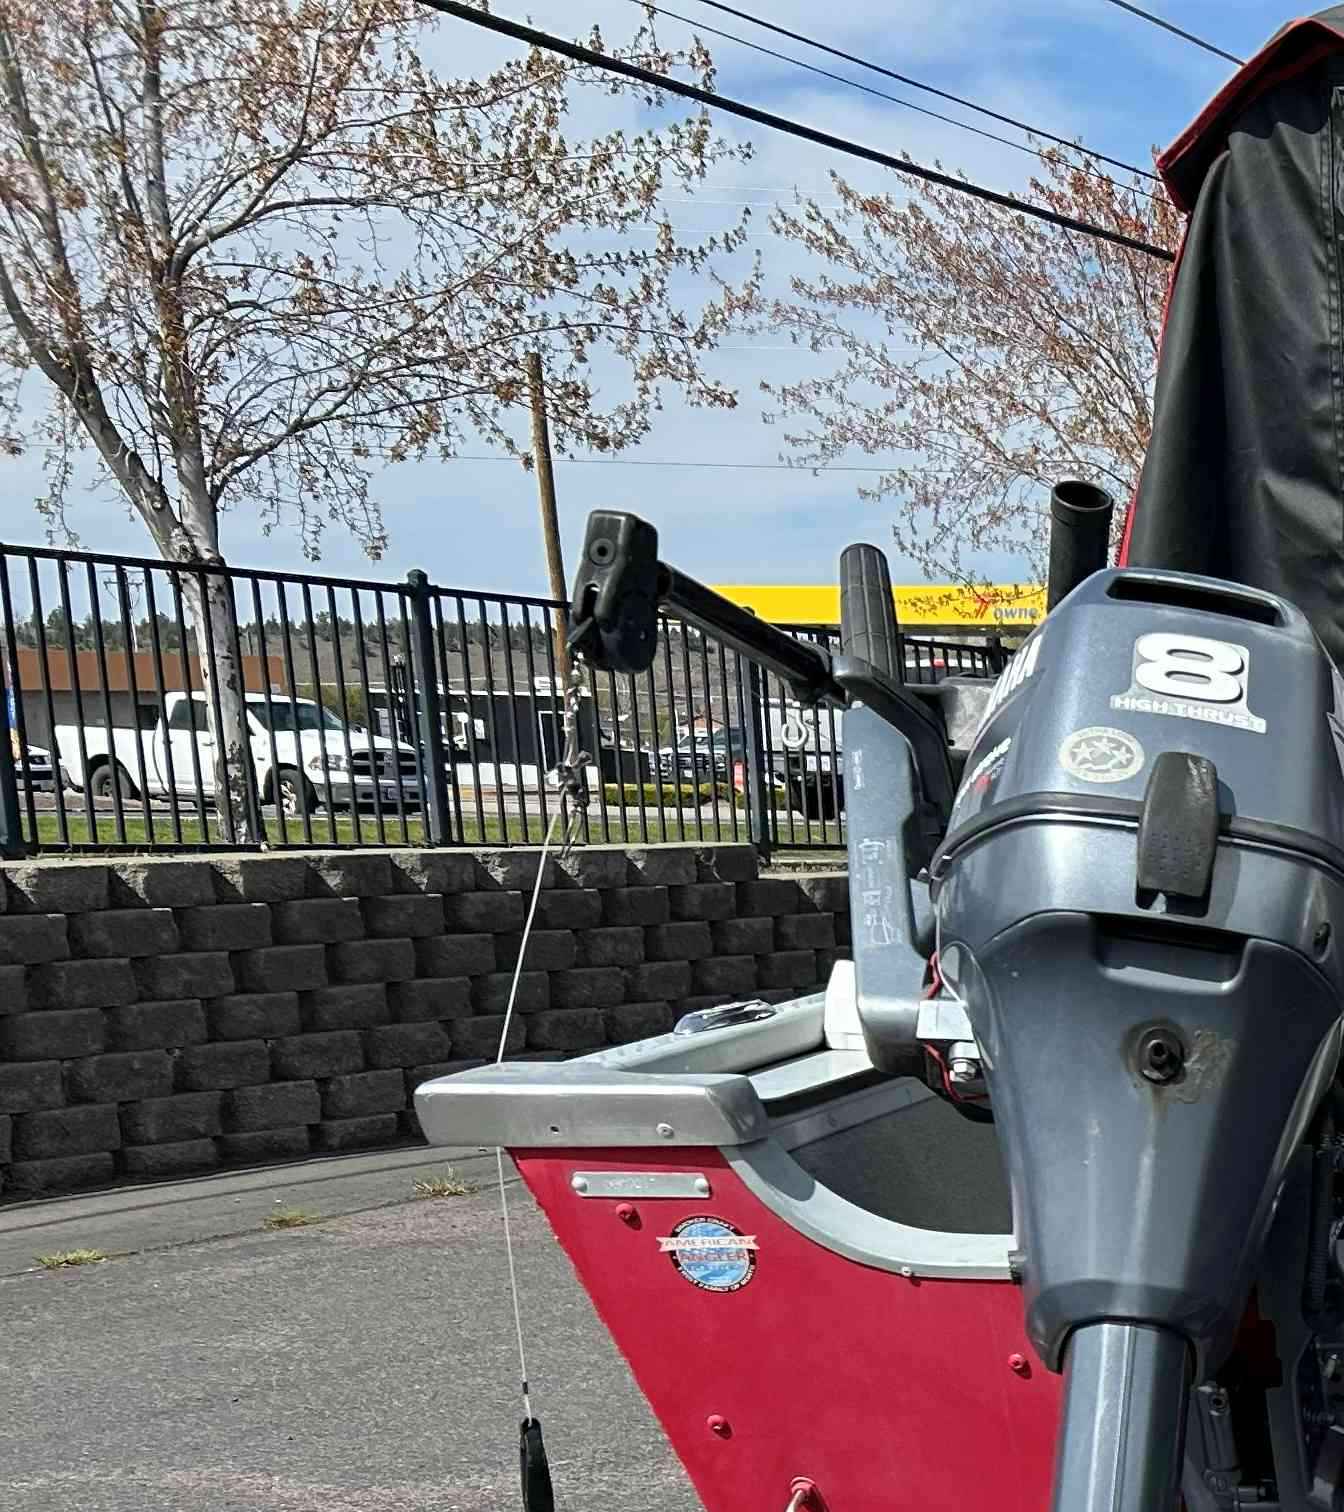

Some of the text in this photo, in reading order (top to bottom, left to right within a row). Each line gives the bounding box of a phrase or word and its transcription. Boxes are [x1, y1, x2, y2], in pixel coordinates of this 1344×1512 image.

[1135, 632, 1245, 704] 8
[1115, 697, 1169, 713] HIGH
[664, 1238, 753, 1248] AMERICAN
